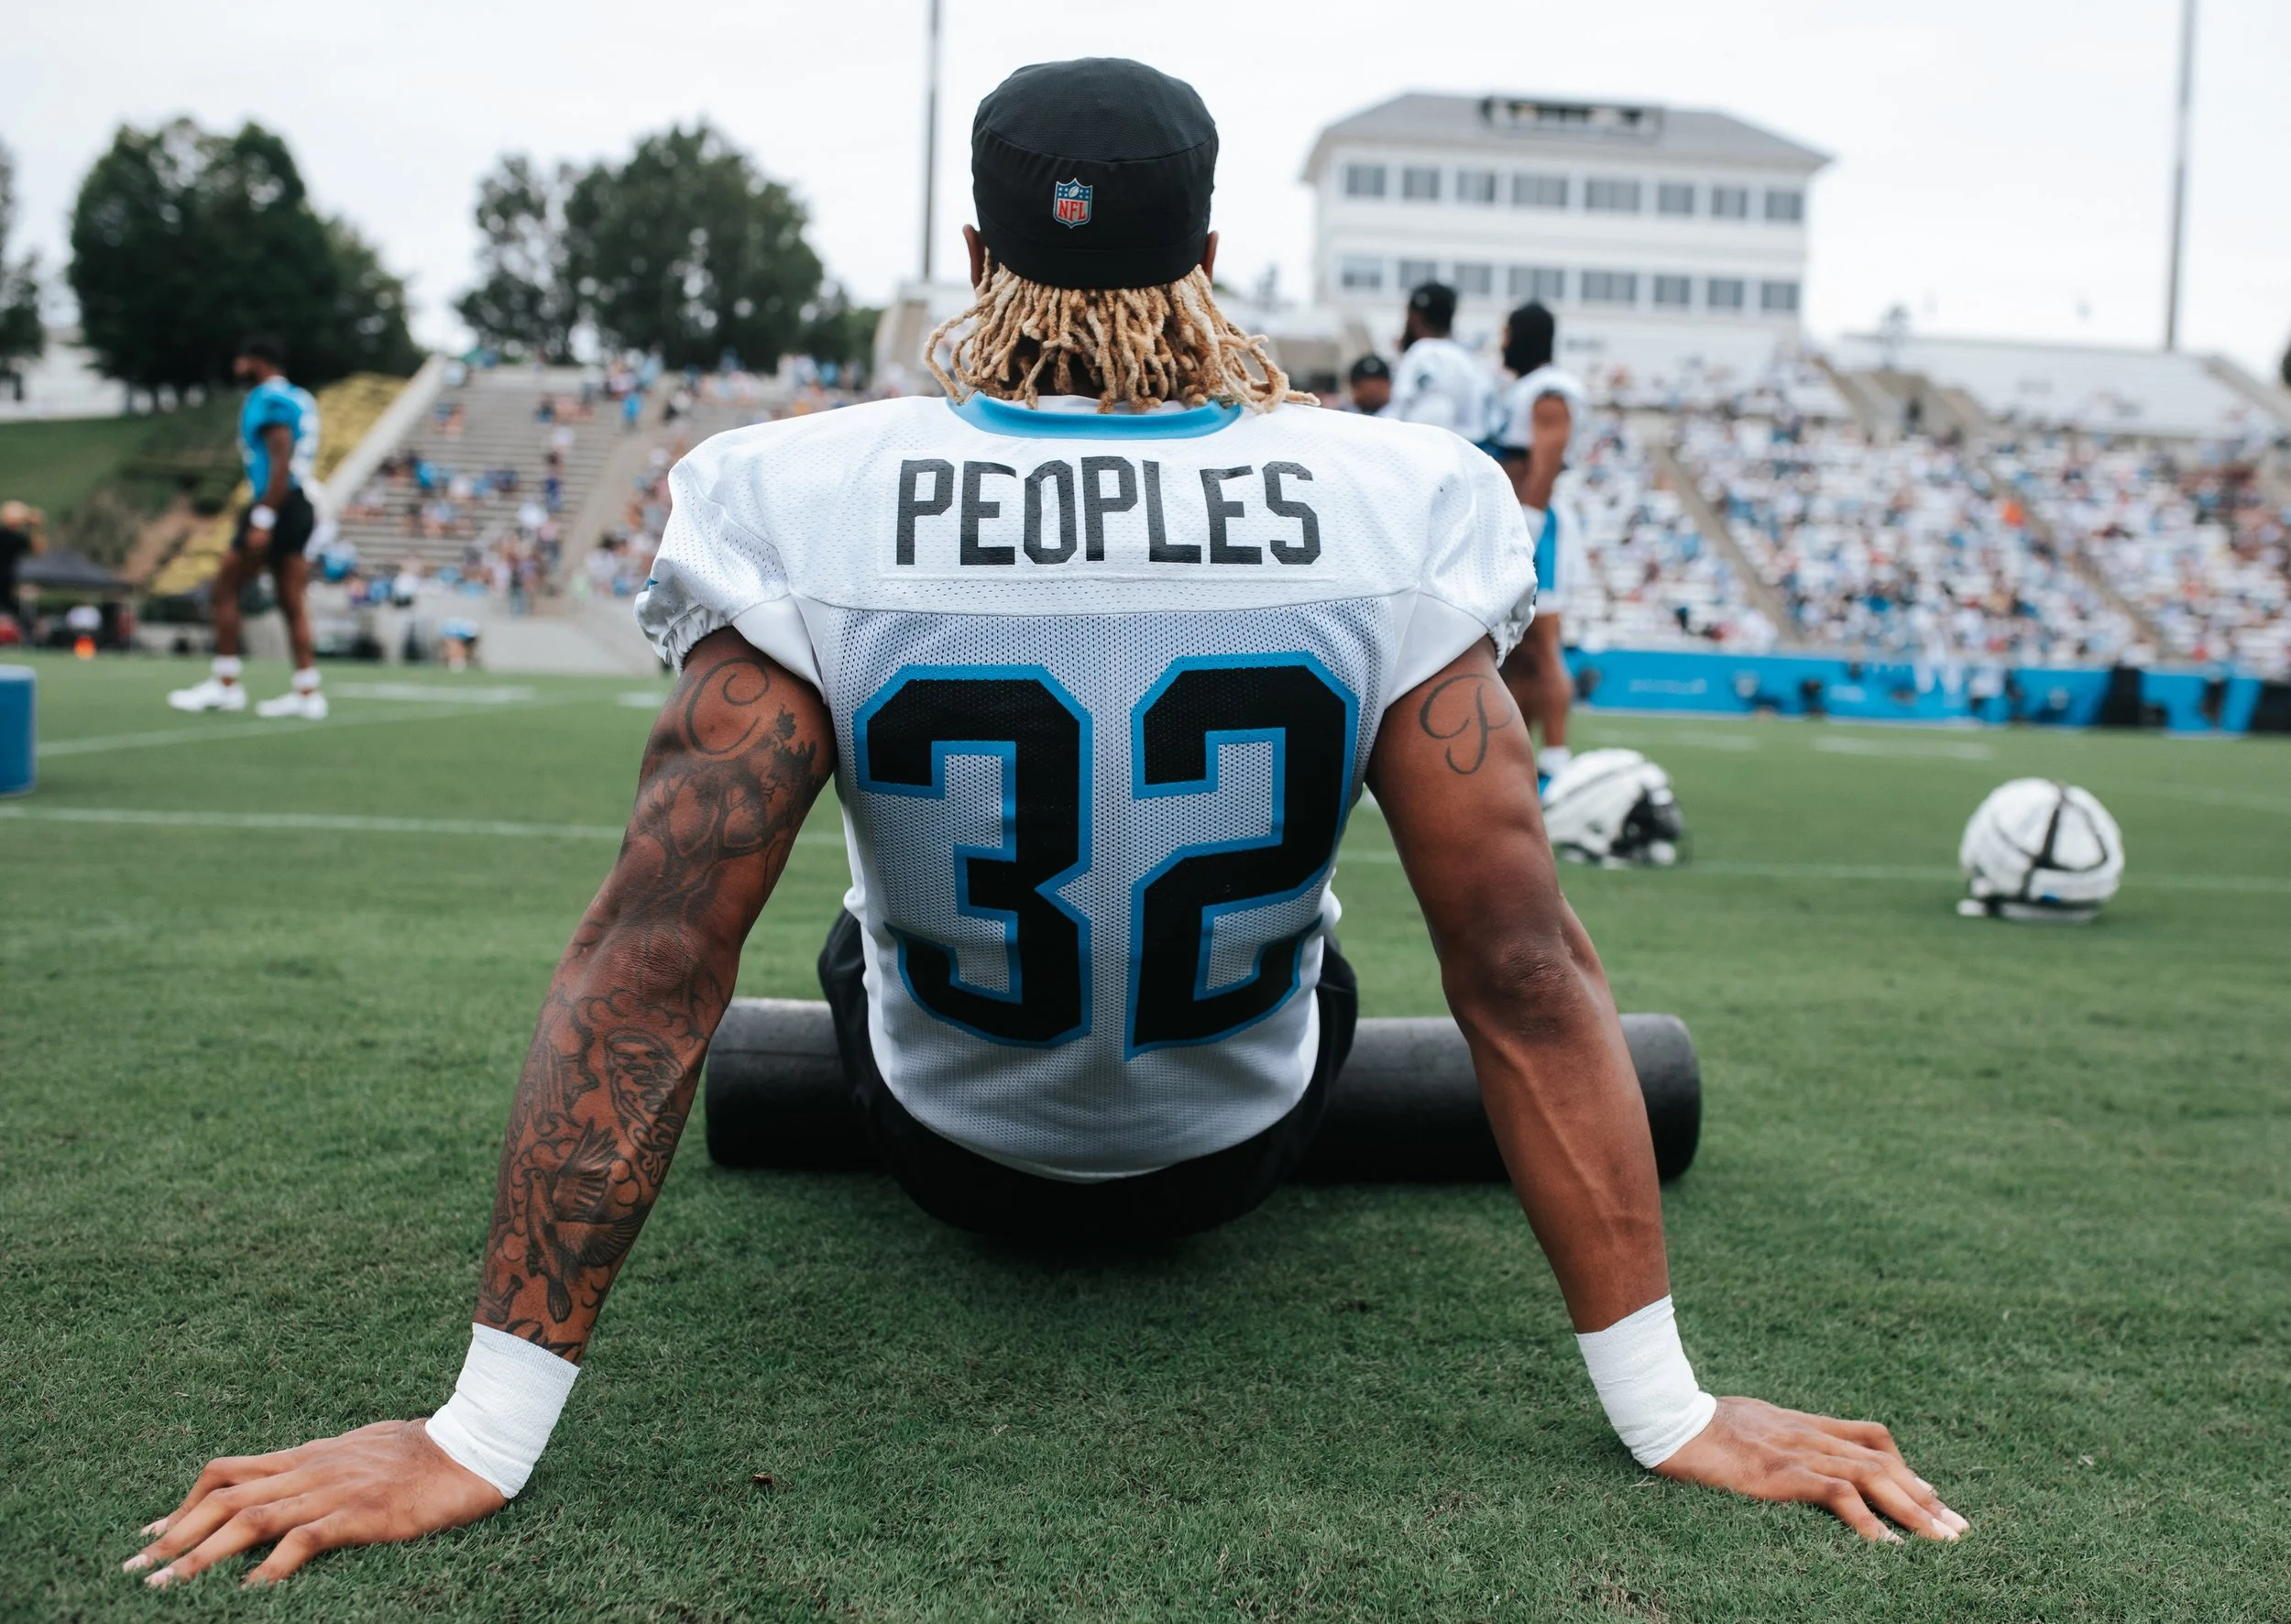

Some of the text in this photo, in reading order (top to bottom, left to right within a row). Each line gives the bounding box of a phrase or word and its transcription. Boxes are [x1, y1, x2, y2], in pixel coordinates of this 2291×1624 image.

[1058, 199, 1087, 222] NFL
[896, 455, 1321, 565] PEOPLES
[853, 651, 1358, 1061] 32
